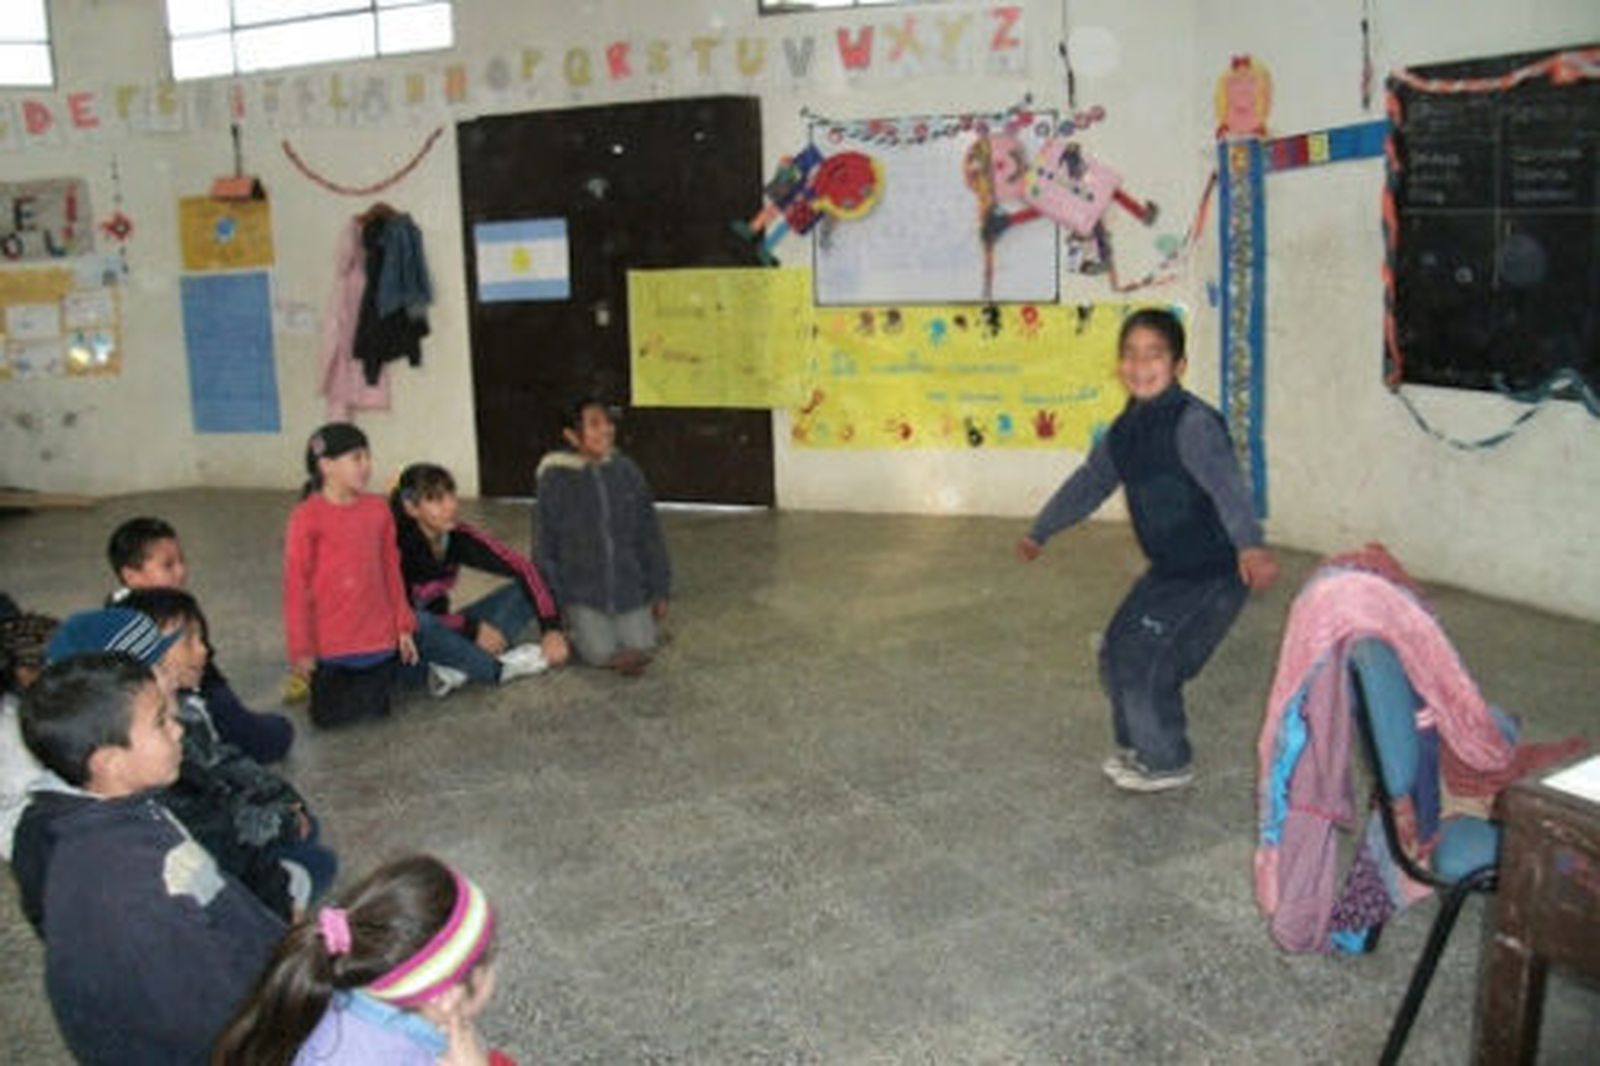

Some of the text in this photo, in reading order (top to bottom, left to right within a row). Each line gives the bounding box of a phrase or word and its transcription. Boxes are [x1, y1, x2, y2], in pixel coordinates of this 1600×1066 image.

[22, 97, 52, 136] D
[67, 91, 99, 128] E
[692, 36, 720, 77] T
[735, 37, 767, 76] U
[783, 36, 815, 77] V
[836, 25, 874, 70] W
[885, 14, 925, 61] X
[992, 6, 1021, 51] Z
